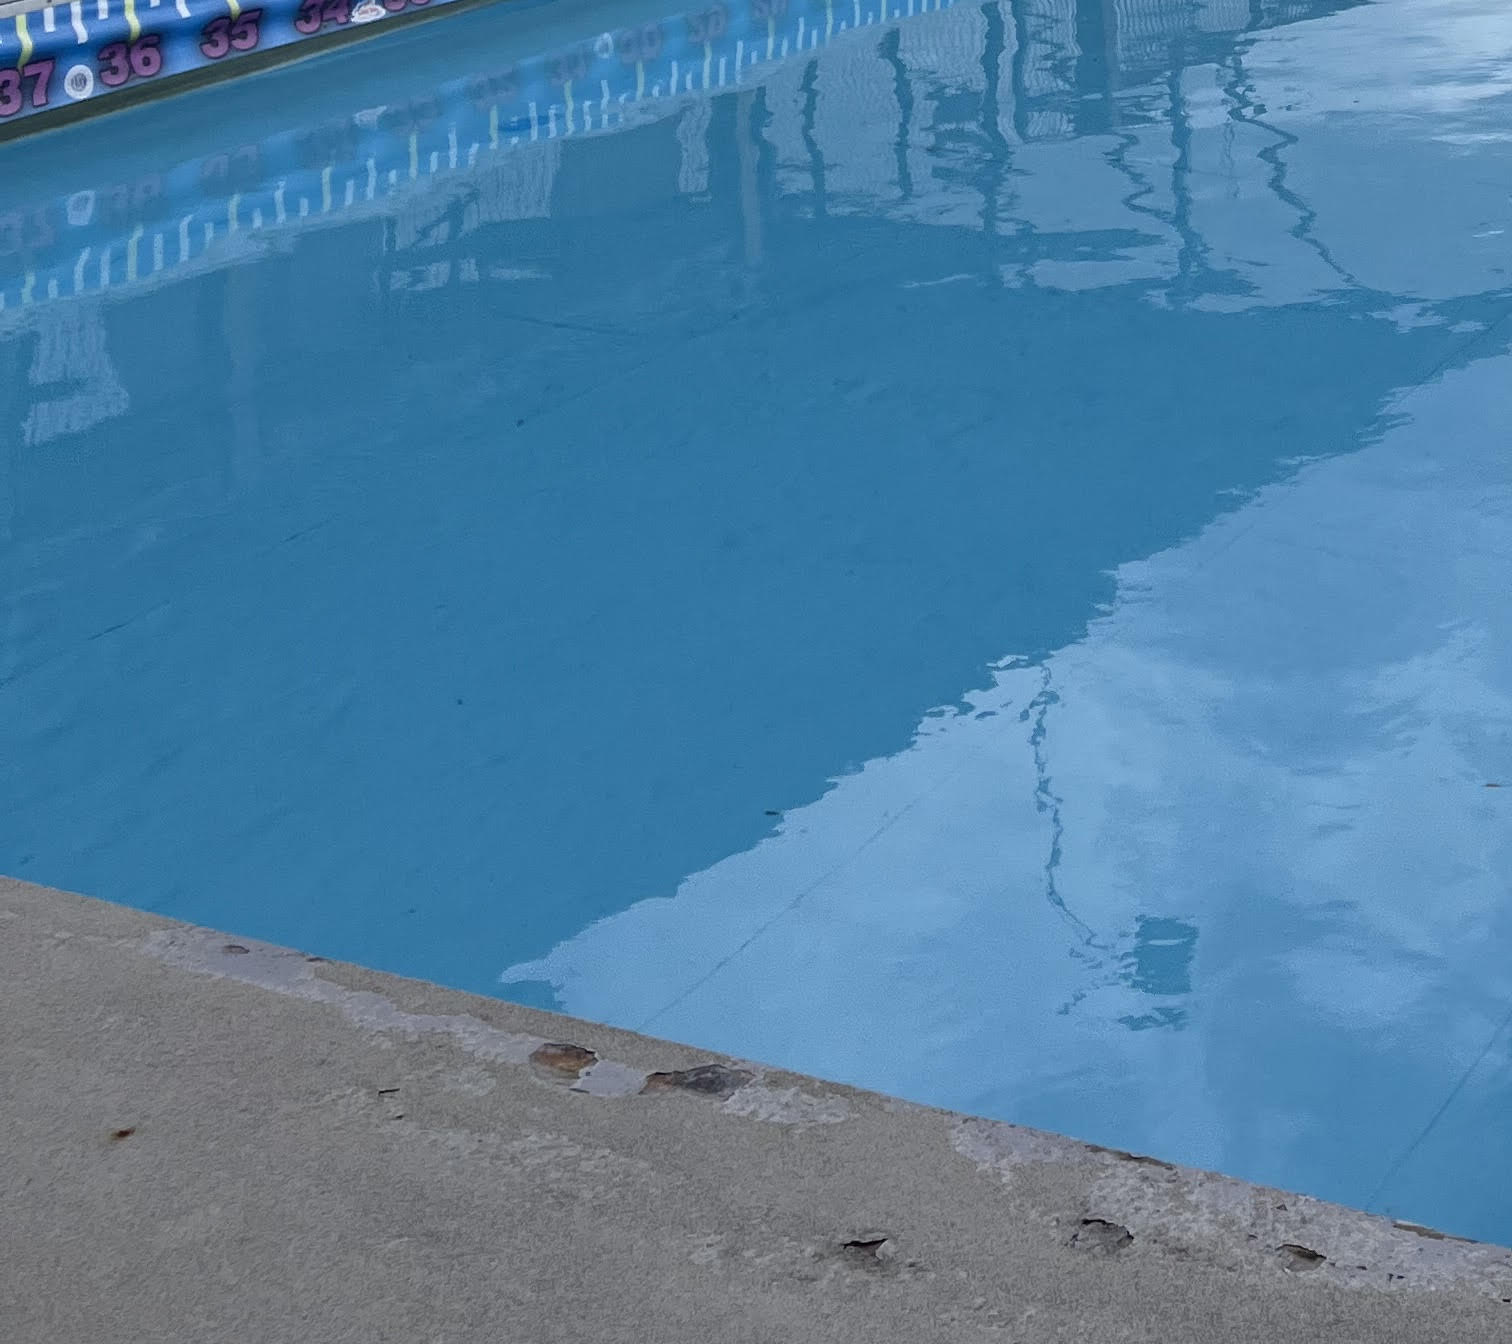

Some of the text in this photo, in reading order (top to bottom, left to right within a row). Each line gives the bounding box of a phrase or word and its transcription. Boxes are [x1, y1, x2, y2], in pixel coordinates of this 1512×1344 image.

[0, 58, 55, 117] 37
[98, 34, 163, 87] 36
[200, 8, 263, 59] 35
